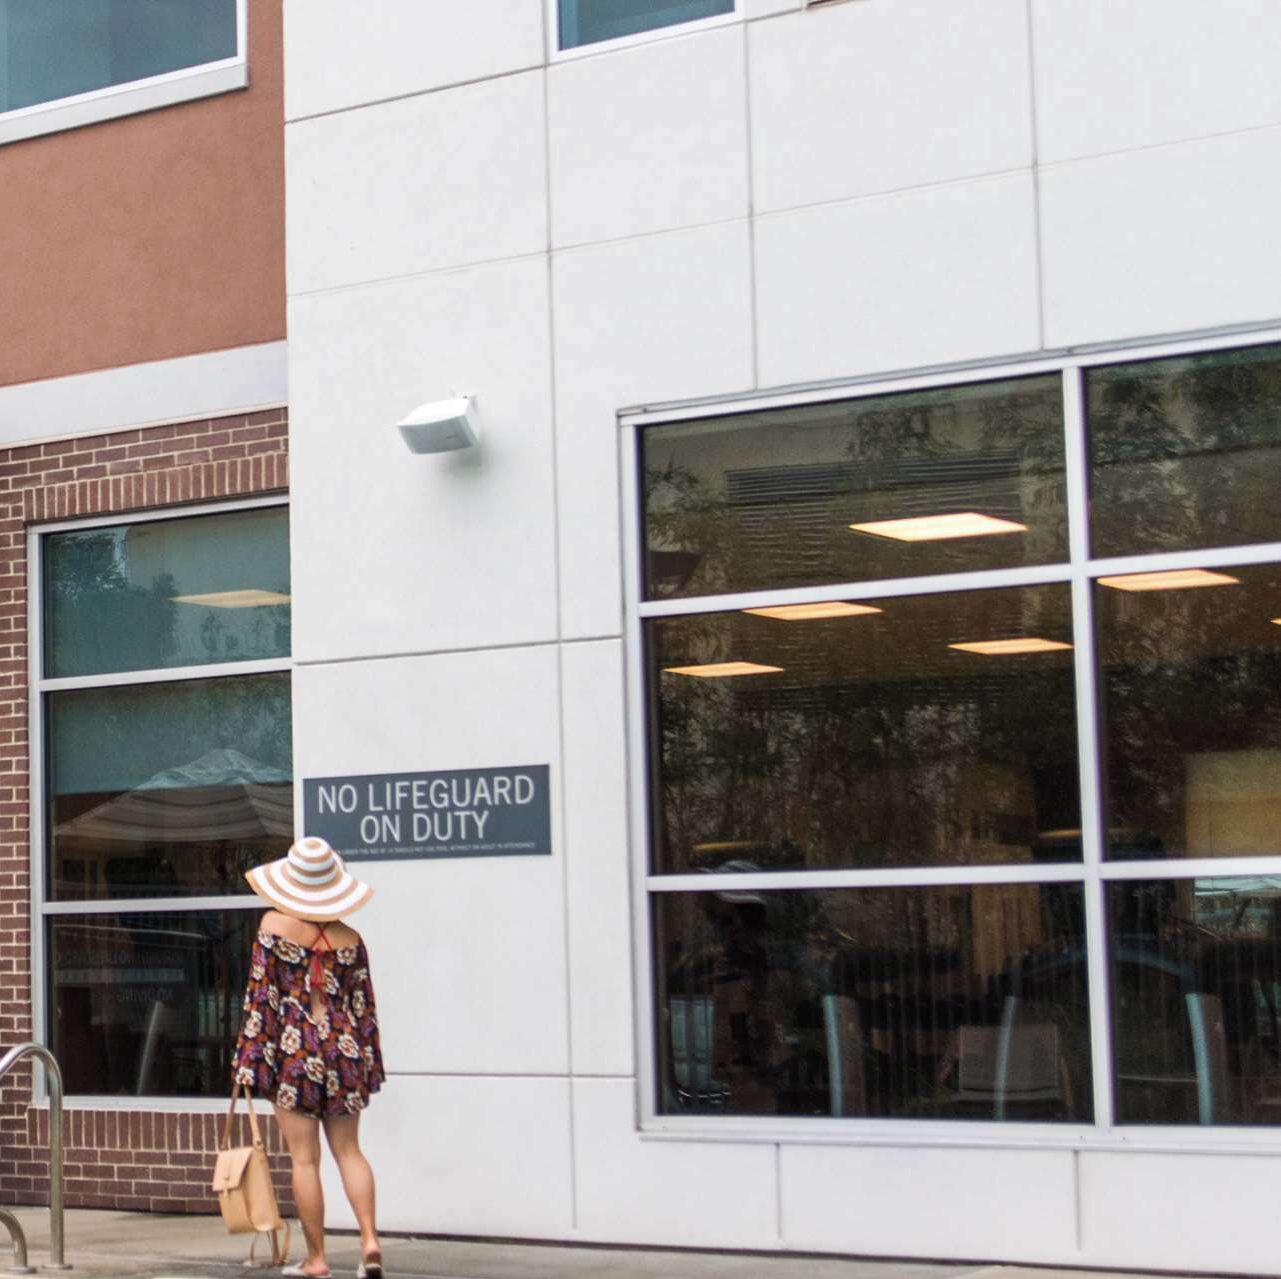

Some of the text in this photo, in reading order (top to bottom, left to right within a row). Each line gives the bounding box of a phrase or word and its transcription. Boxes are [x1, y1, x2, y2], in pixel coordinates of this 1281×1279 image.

[318, 775, 535, 814] NO LIFEGUARD
[360, 810, 489, 844] ON DUTY
